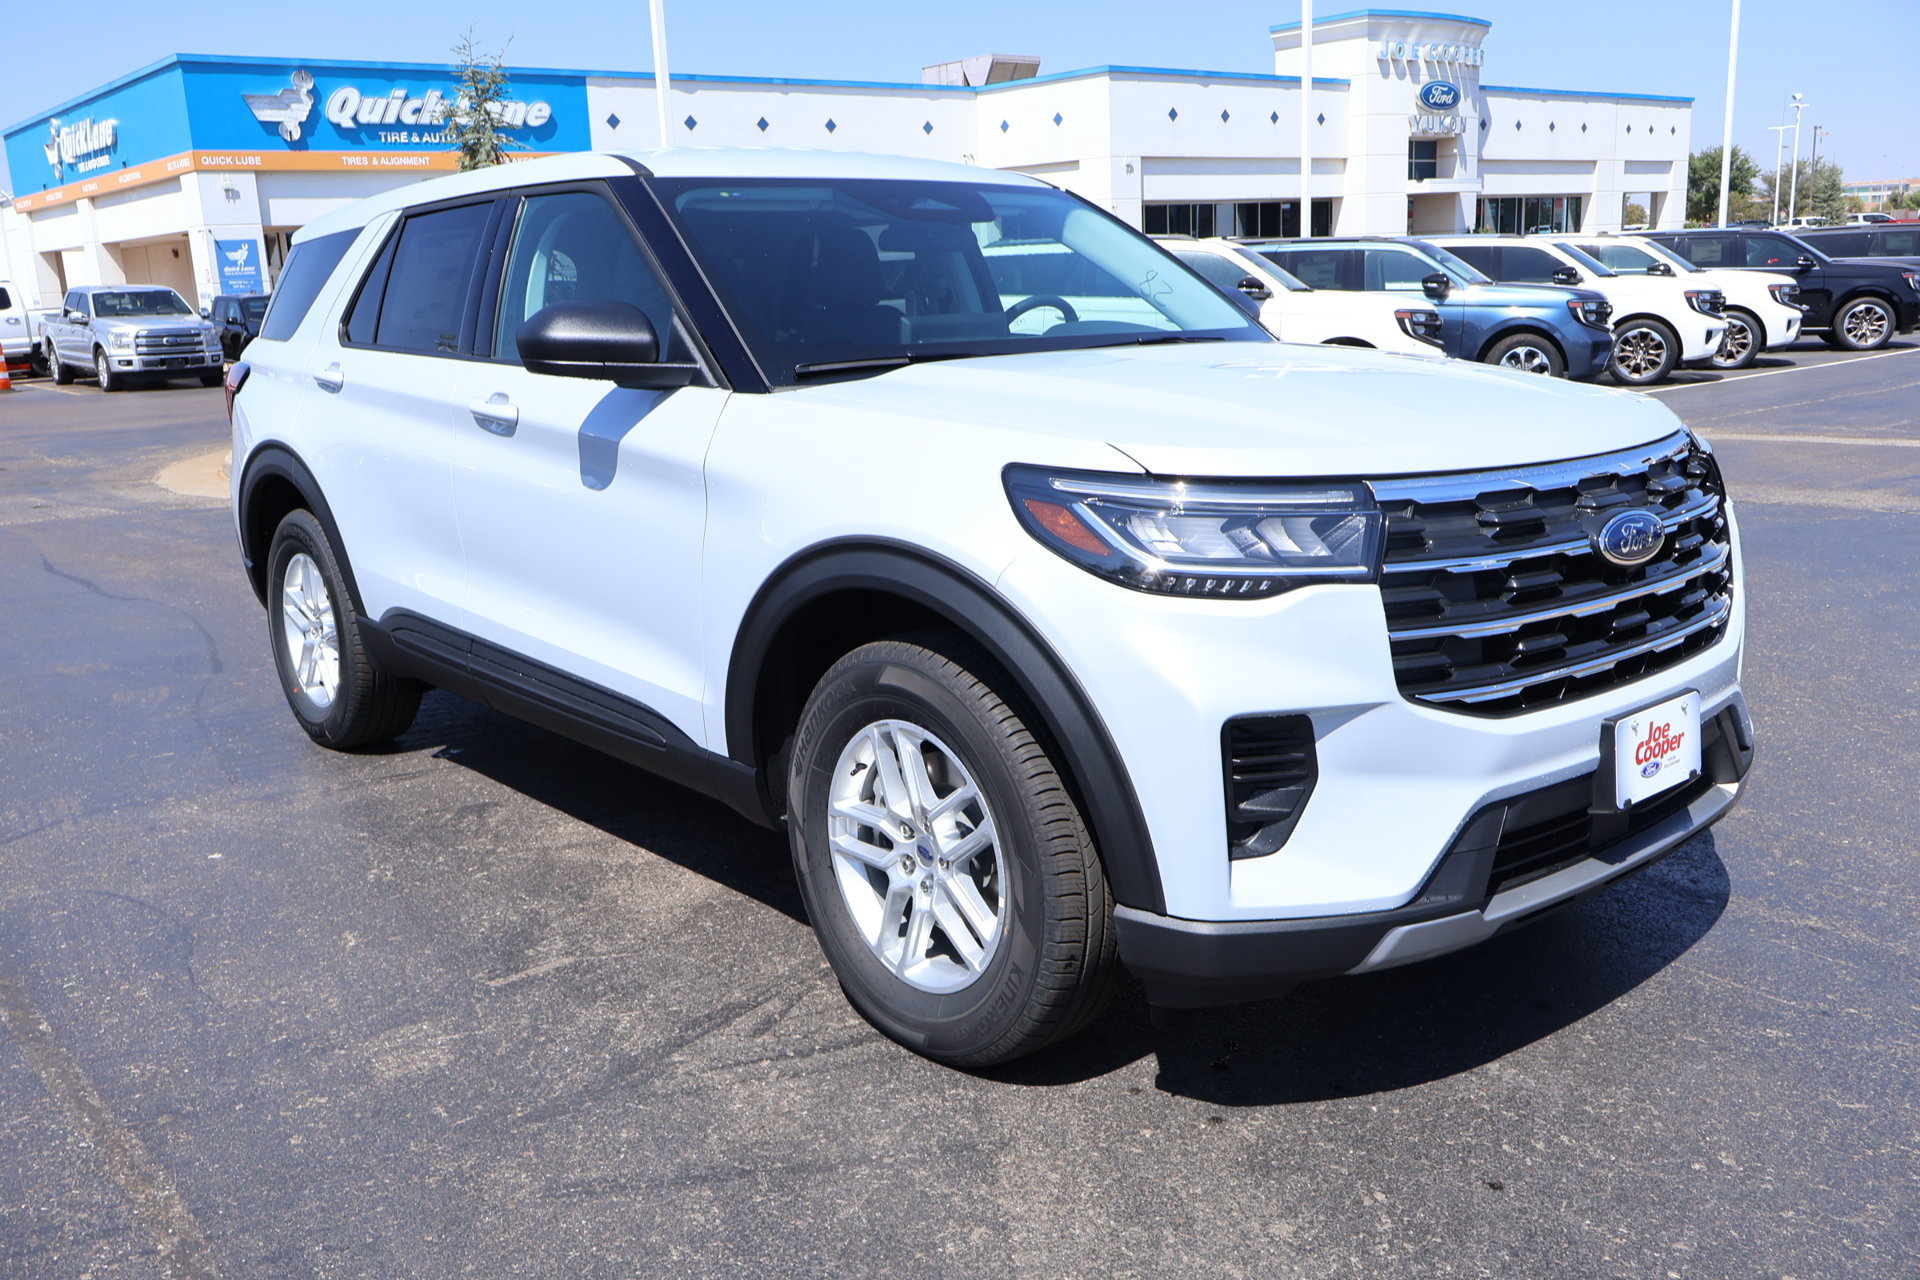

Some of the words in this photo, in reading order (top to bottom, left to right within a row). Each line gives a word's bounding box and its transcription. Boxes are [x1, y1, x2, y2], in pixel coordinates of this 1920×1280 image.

[1378, 41, 1420, 60] JOE
[1424, 44, 1484, 65] COOPER
[326, 87, 445, 128] Quick
[1411, 115, 1466, 132] YUKON
[379, 132, 408, 143] TIRE
[411, 132, 420, 143] &
[201, 156, 233, 165] QUICK
[235, 156, 262, 165] LUBE
[341, 156, 368, 165] TIRES
[372, 156, 379, 165] &
[380, 156, 430, 165] ALIGNMENT
[1645, 721, 1670, 746] Joe
[1635, 732, 1684, 765] Cooper
